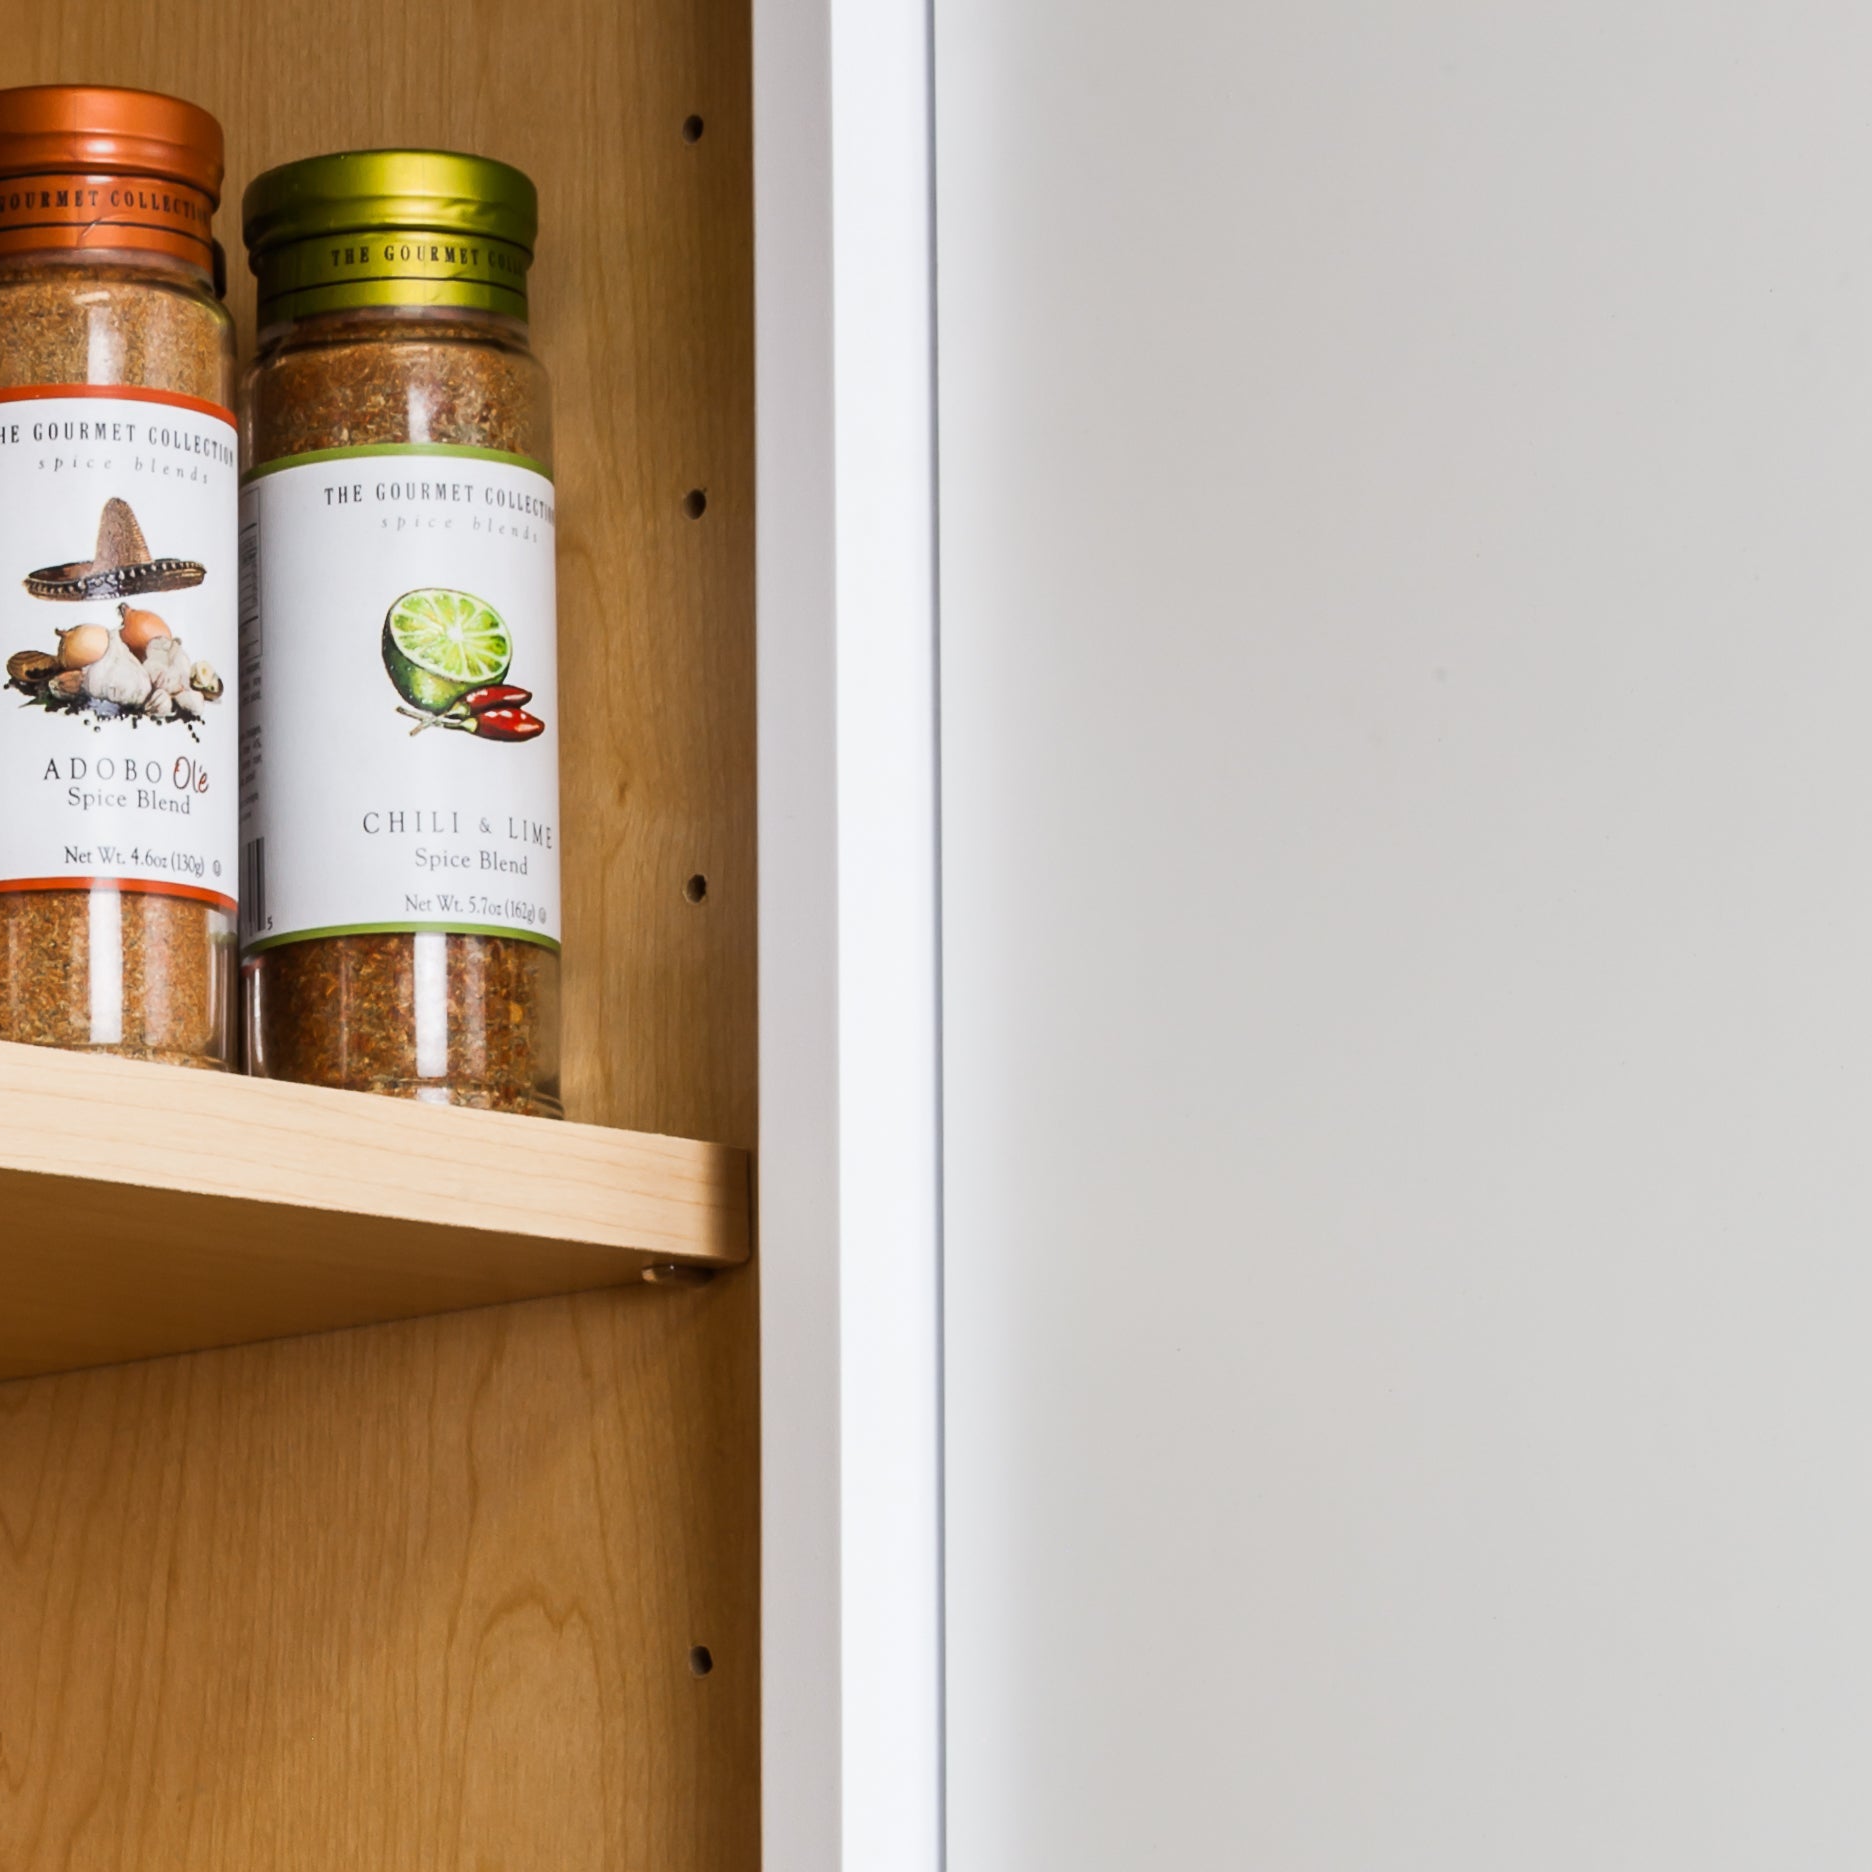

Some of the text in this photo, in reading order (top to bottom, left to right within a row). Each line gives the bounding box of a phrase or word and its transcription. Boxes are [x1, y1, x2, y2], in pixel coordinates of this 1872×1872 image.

[331, 245, 370, 267] THE
[383, 244, 480, 267] GOURMET
[32, 421, 137, 444] GOURMET
[147, 426, 235, 469] COLLECTION
[323, 483, 364, 506] THE
[375, 481, 475, 503] GOURMET
[43, 757, 163, 785] ADOBO
[67, 786, 192, 816] Spice Blend
[362, 810, 554, 850] CHILI & LIME
[64, 845, 93, 865] Net
[97, 845, 127, 866] Wt.
[170, 851, 206, 877] (130g)
[414, 847, 529, 876] Spice Blend
[404, 893, 432, 913] Net
[435, 893, 464, 914] Wt.
